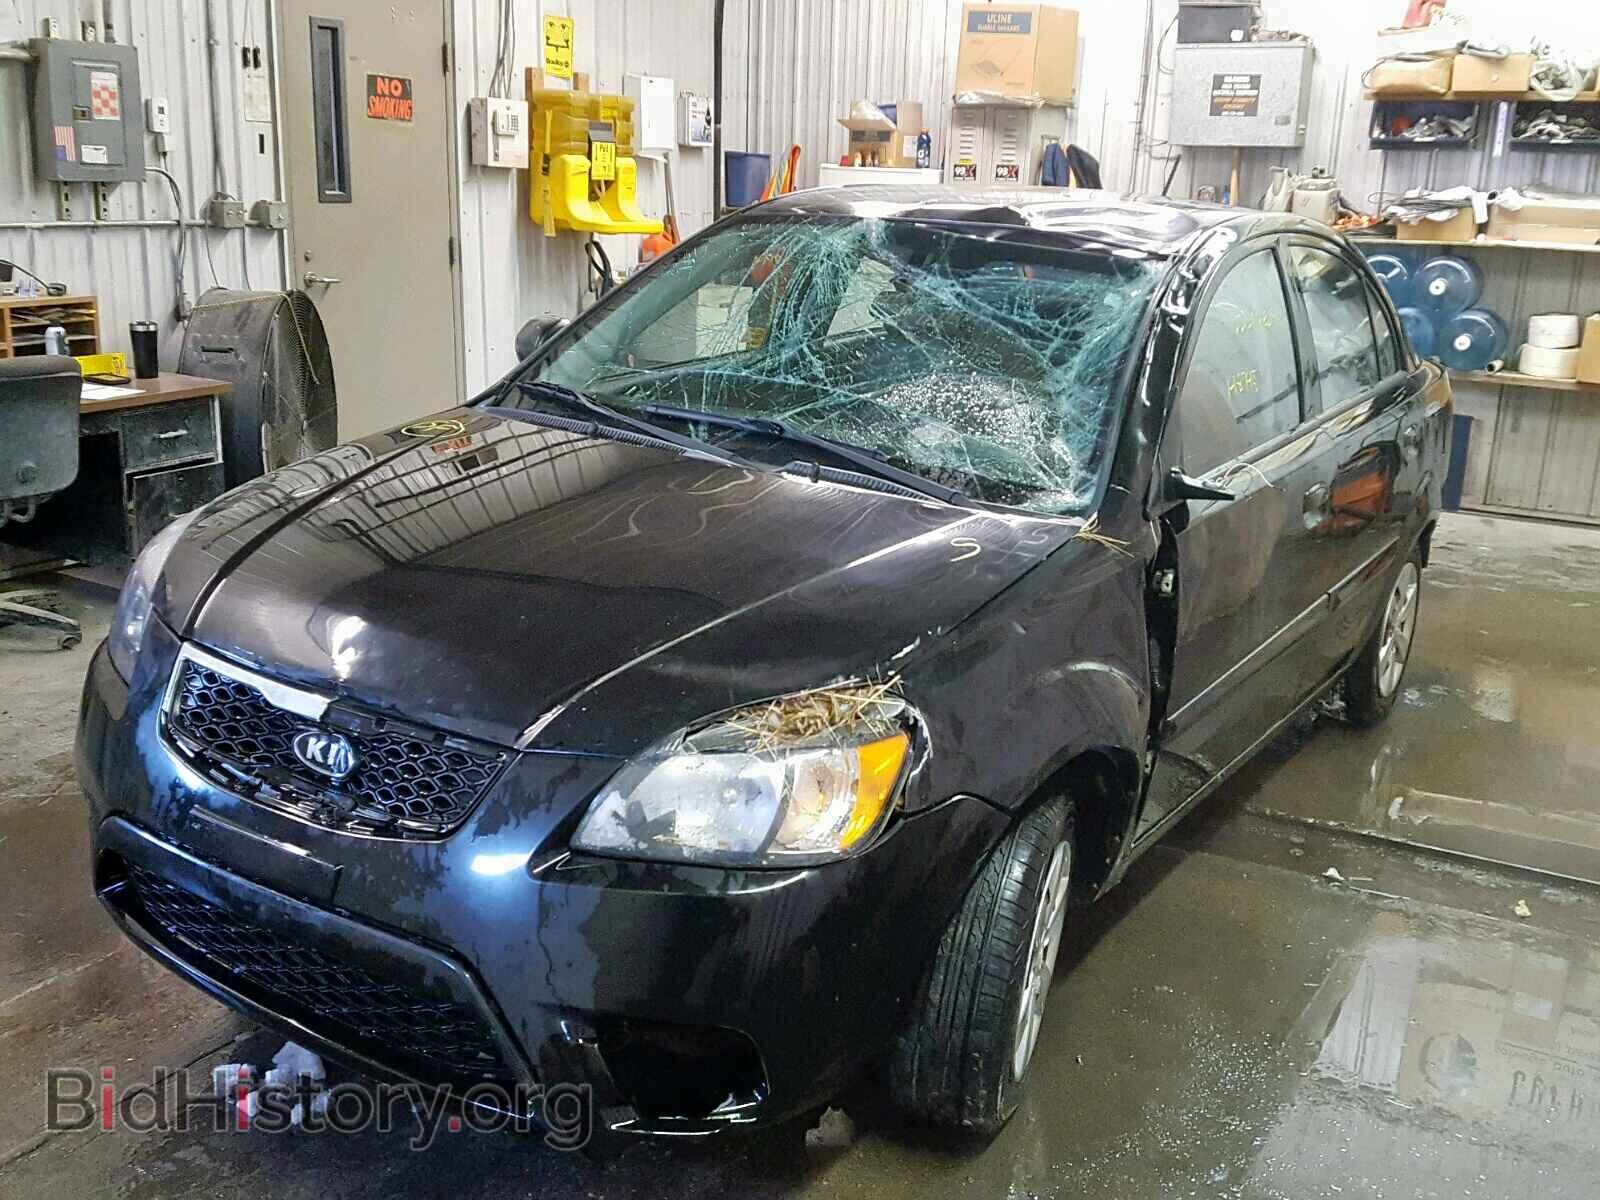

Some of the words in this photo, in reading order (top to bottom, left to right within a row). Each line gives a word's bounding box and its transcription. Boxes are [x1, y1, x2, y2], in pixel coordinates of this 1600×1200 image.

[987, 13, 1013, 24] ULINE
[376, 76, 403, 97] NO
[367, 95, 412, 120] SMOKING
